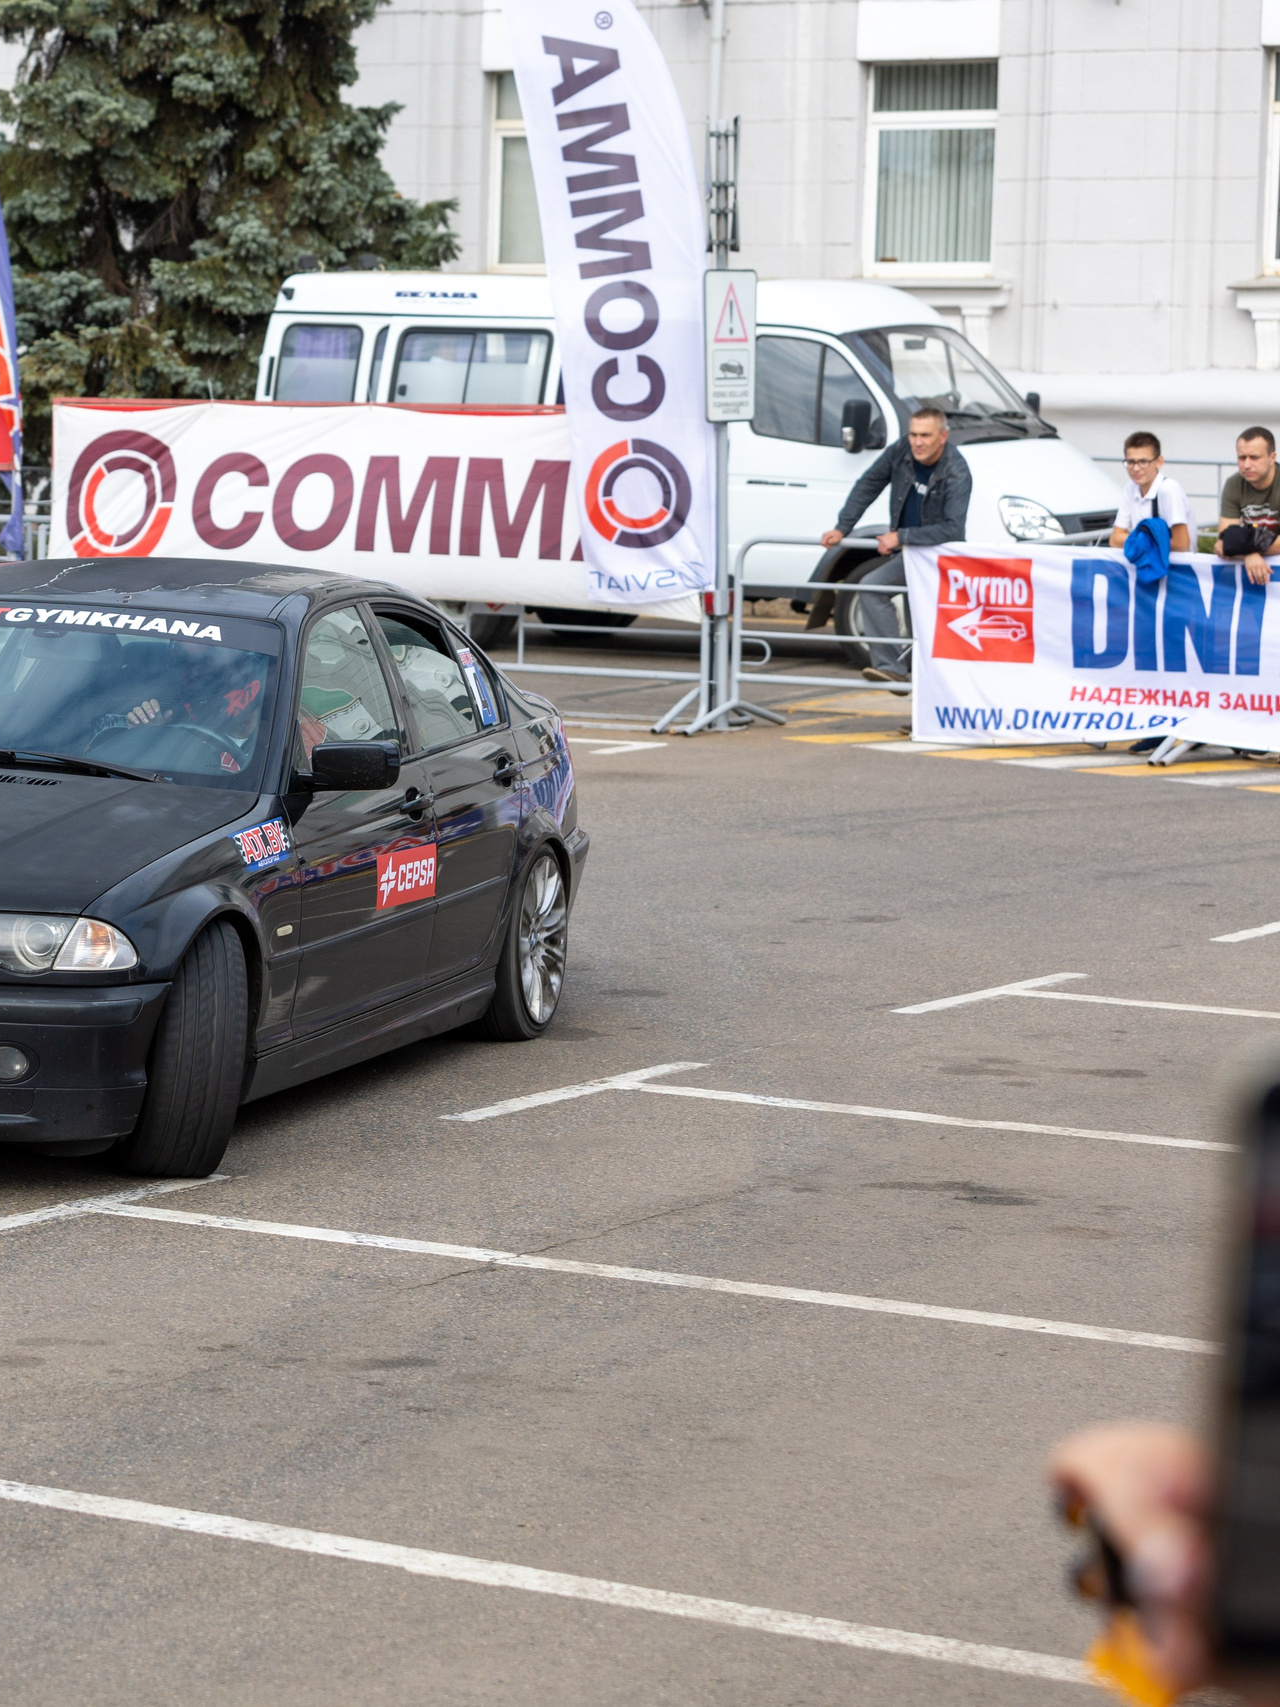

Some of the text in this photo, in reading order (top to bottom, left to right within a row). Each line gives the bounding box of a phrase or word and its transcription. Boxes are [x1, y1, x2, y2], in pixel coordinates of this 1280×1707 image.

[191, 452, 585, 562] COMM
[947, 568, 1028, 609] Pyrmo
[935, 705, 1189, 731] WWW.DINITROL.BY
[1070, 685, 1280, 716] НАДЕЖНАЯ ЗАЩ
[239, 820, 286, 865] ADT.BY
[397, 856, 435, 892] CEPSA
